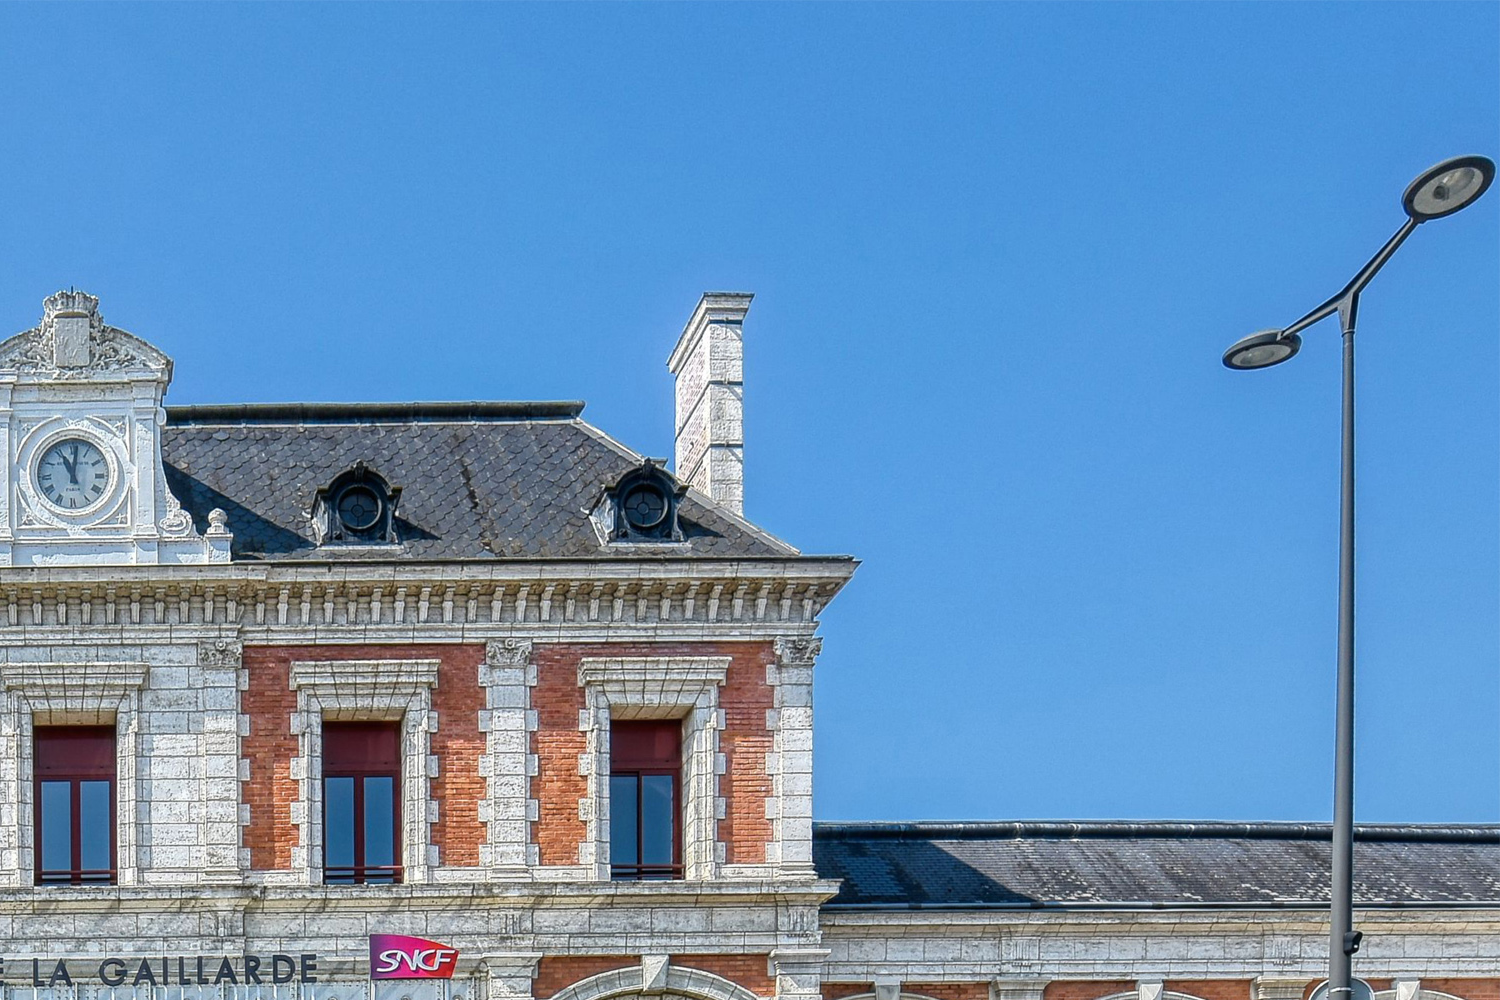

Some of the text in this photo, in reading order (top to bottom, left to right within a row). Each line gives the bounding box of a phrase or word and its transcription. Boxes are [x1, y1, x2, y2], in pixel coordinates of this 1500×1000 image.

[33, 957, 72, 987] LA
[100, 954, 317, 987] GAILLARDE
[376, 949, 456, 972] SNCF
